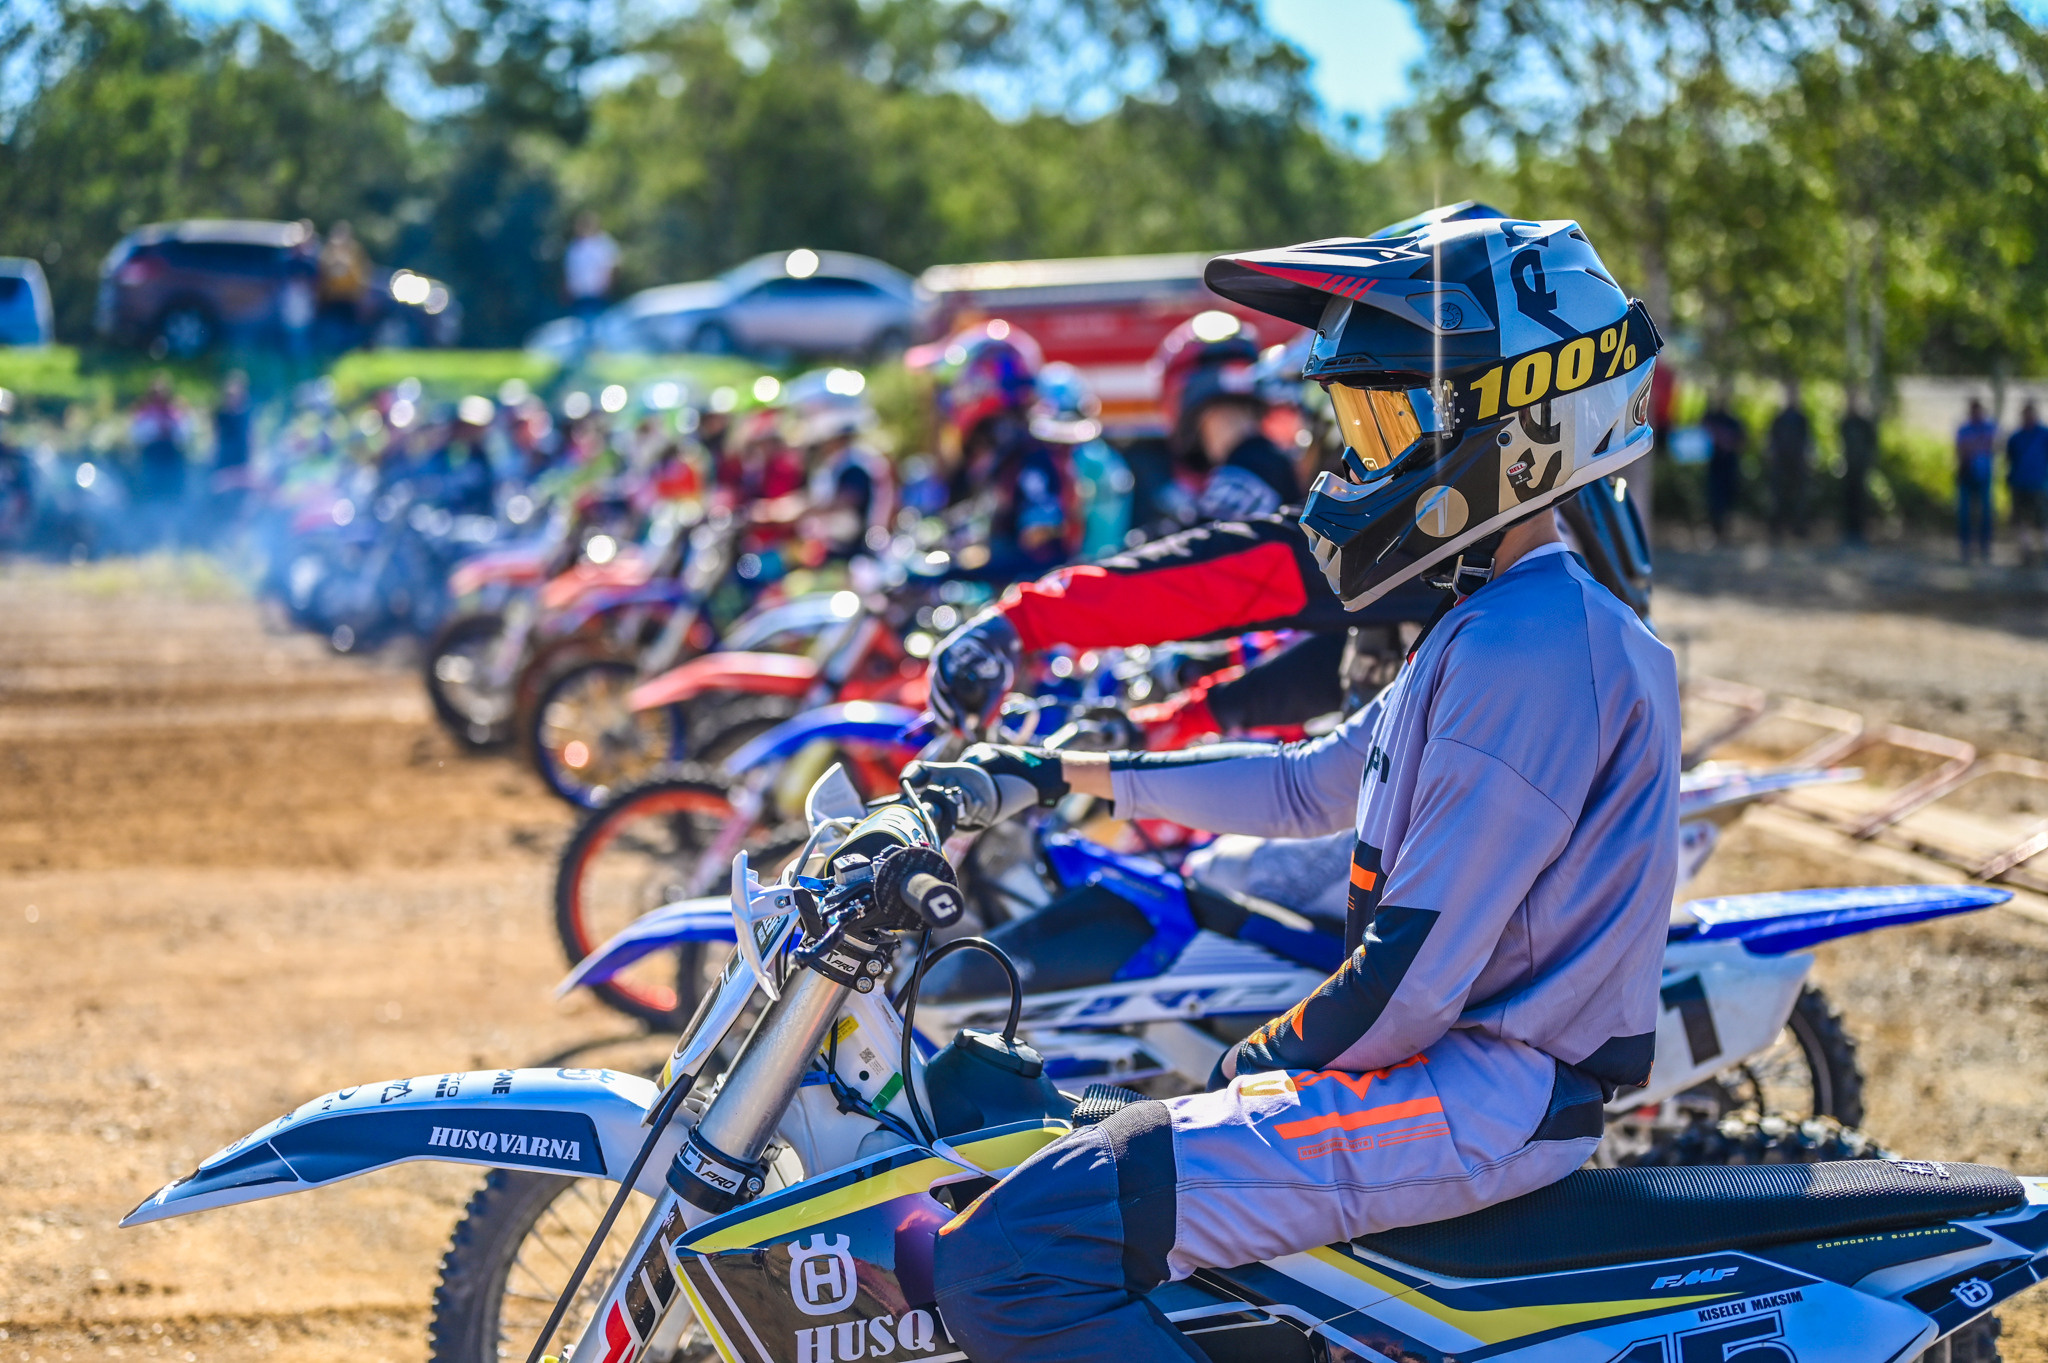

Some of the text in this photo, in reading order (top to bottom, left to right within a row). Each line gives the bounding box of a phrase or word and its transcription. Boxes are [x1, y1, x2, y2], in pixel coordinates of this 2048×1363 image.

[1470, 319, 1637, 421] 100%
[1508, 464, 1527, 474] BELL
[428, 1126, 581, 1161] HUSQVARNA
[701, 1170, 737, 1190] PRO
[1816, 1227, 1957, 1249] COMPOSITE SUBFRAME
[1651, 1266, 1740, 1290] FMF
[1697, 1290, 1804, 1323] KISELEV MAKSIM
[794, 1306, 955, 1363] HUSQ
